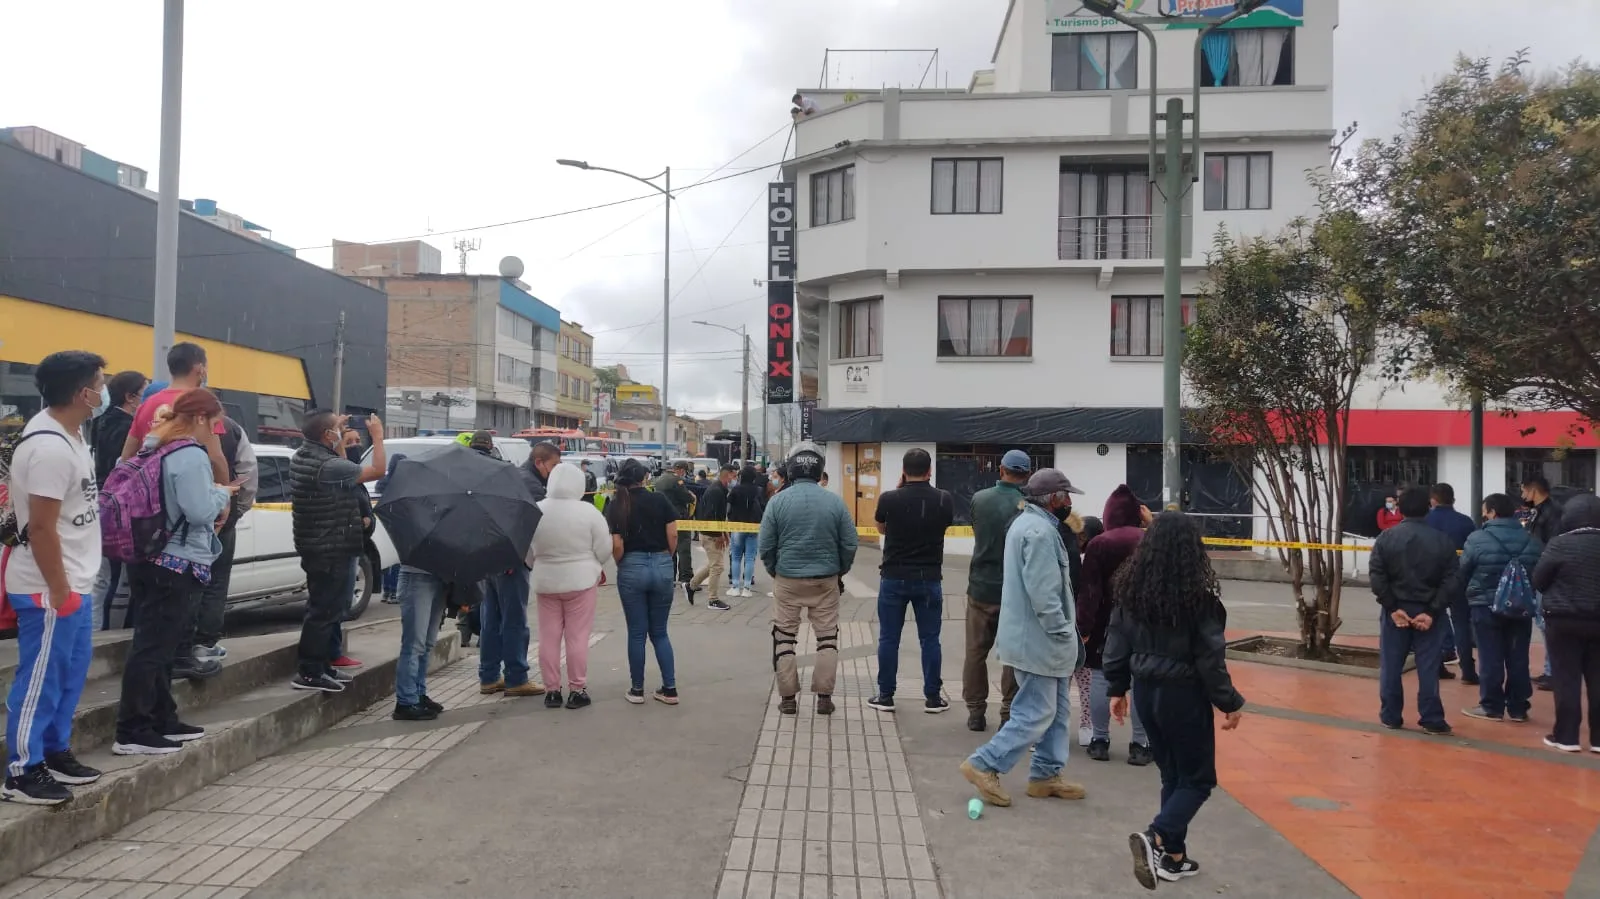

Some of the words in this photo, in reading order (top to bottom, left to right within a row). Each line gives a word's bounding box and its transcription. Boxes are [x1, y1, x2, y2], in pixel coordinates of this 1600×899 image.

[1054, 18, 1100, 27] Turismo
[770, 187, 792, 281] HOTEL
[769, 303, 792, 377] ONIX
